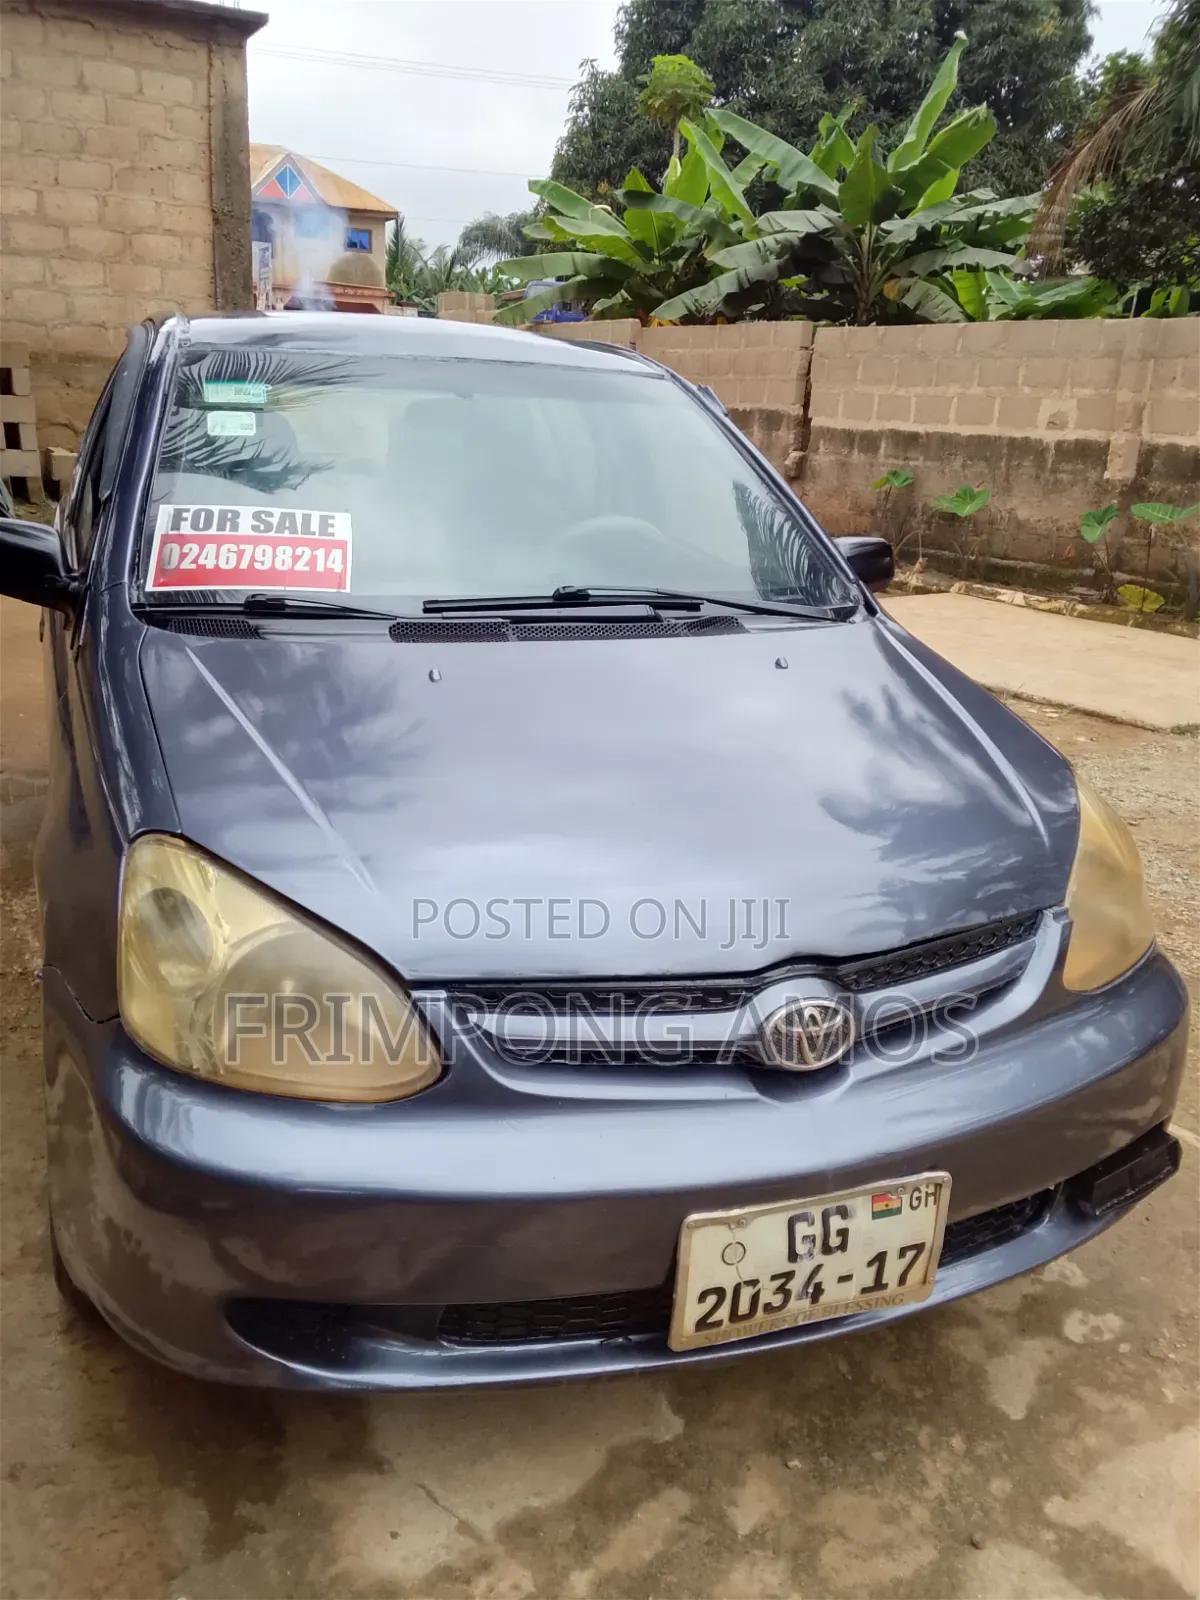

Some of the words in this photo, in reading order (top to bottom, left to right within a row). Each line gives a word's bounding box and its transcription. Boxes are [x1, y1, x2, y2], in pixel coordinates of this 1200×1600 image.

[172, 508, 241, 532] FOR
[251, 510, 336, 537] SALE
[161, 543, 343, 572] 0246798214
[909, 1186, 938, 1211] GH
[788, 1204, 850, 1263] GG
[694, 1241, 926, 1333] 2034-17
